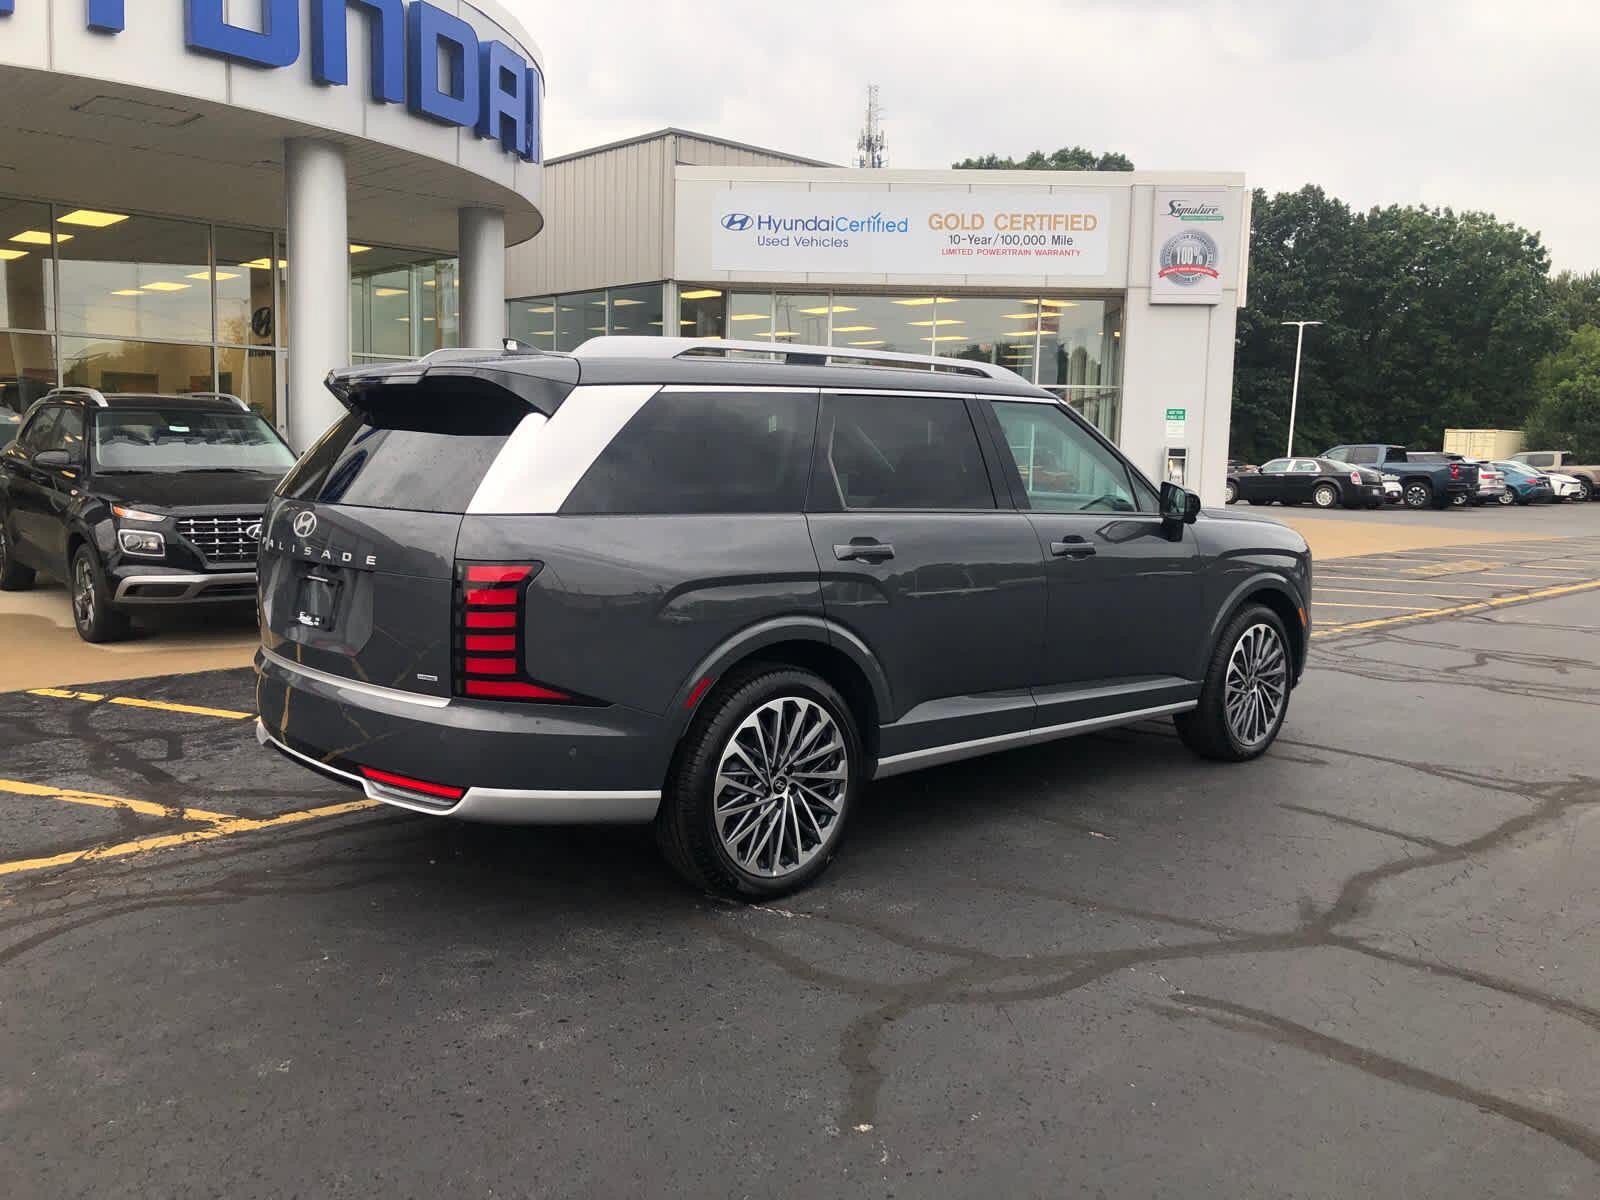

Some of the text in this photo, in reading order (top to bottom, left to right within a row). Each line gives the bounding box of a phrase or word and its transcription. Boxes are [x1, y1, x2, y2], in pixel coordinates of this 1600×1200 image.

[0, 0, 540, 164] NDAI
[1168, 200, 1219, 217] Signature
[928, 213, 1098, 231] GOLD CERTIFIED
[757, 235, 849, 248] Used Vehicles
[949, 233, 1074, 247] 10-Year/100,000 Mile
[941, 248, 1081, 257] LIMITED POWERTRAIN WARRANTY
[1176, 246, 1204, 265] 100%
[262, 536, 377, 566] PALISADE
